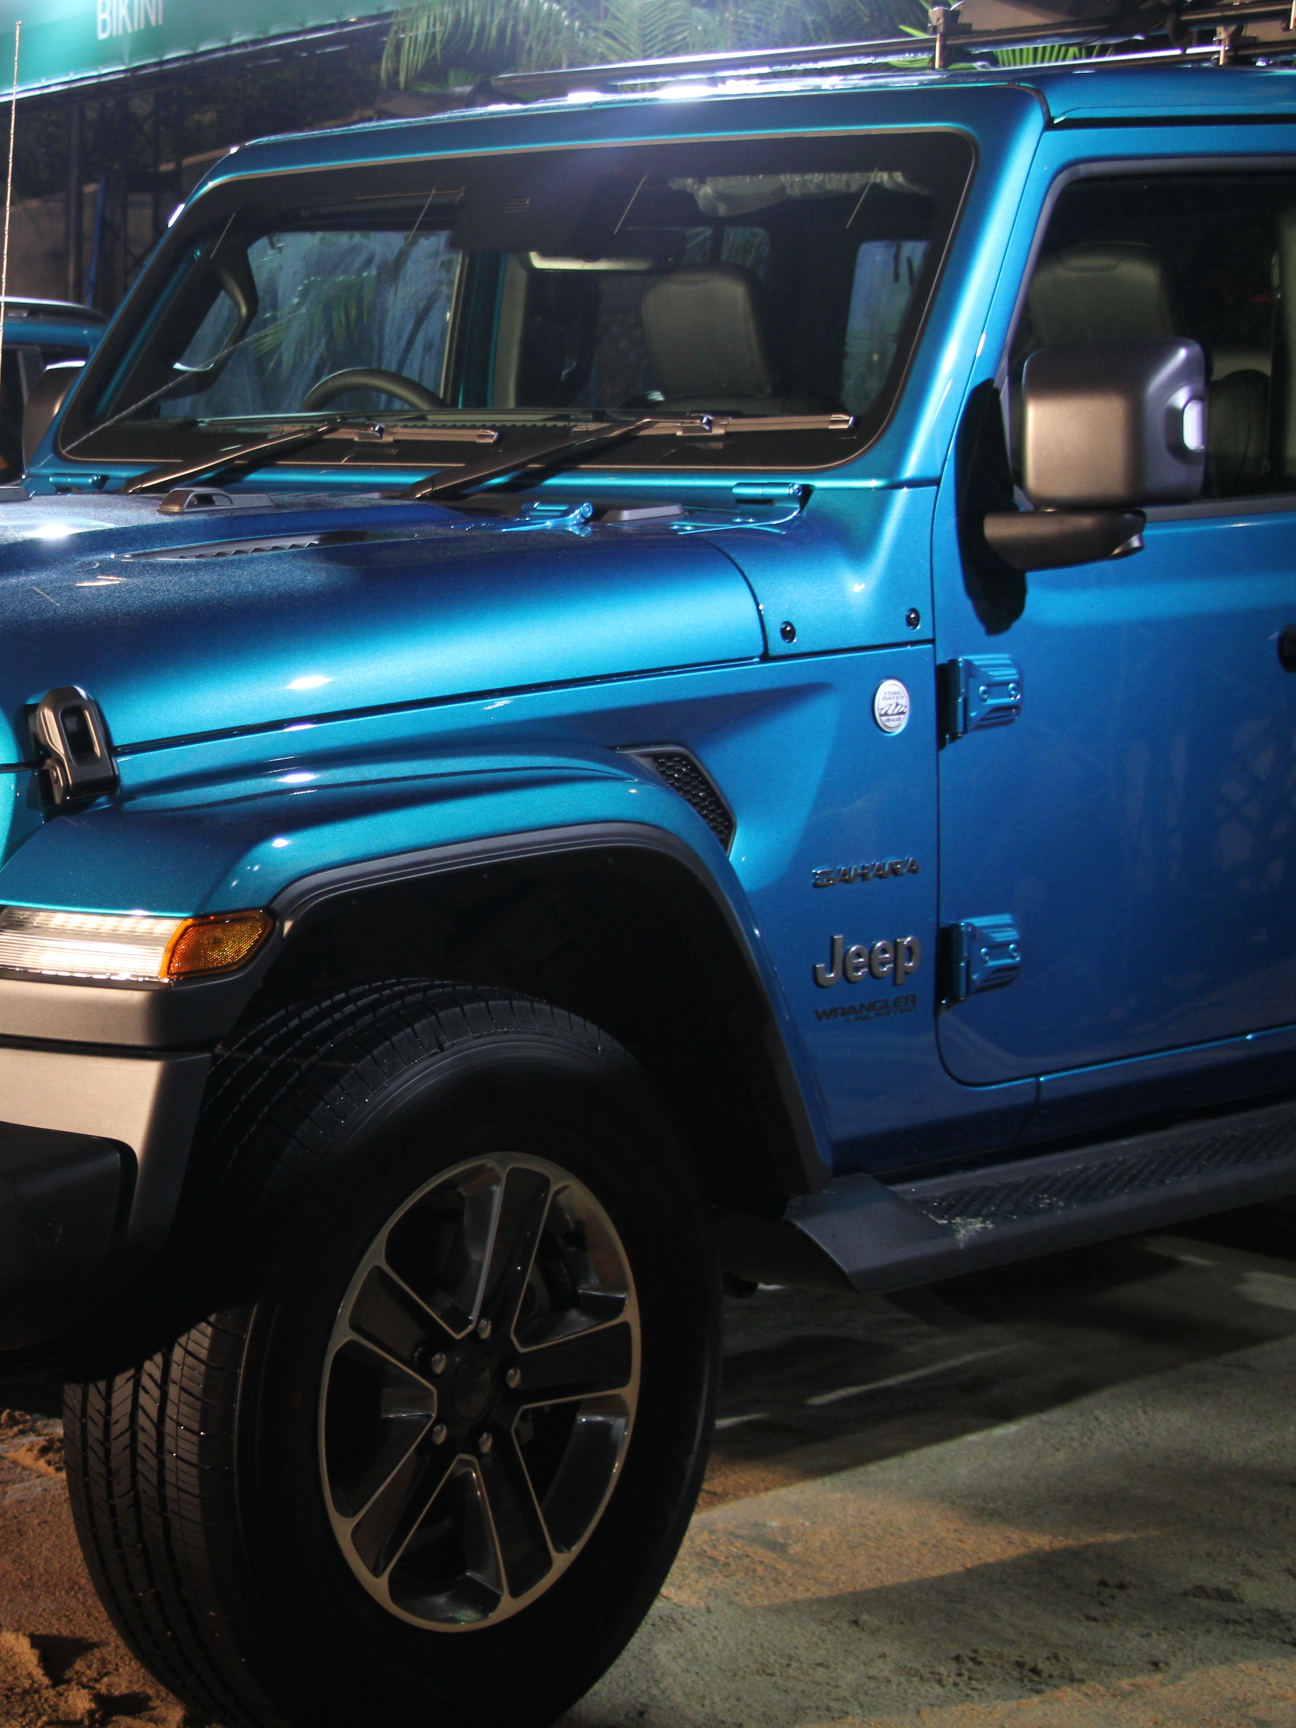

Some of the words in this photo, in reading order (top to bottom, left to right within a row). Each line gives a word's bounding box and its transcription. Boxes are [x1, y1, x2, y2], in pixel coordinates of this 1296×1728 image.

[97, 0, 163, 40] BIKINI
[812, 857, 920, 888] SAHARA
[814, 934, 921, 988] Jeep
[814, 994, 918, 1022] WRANGLER
